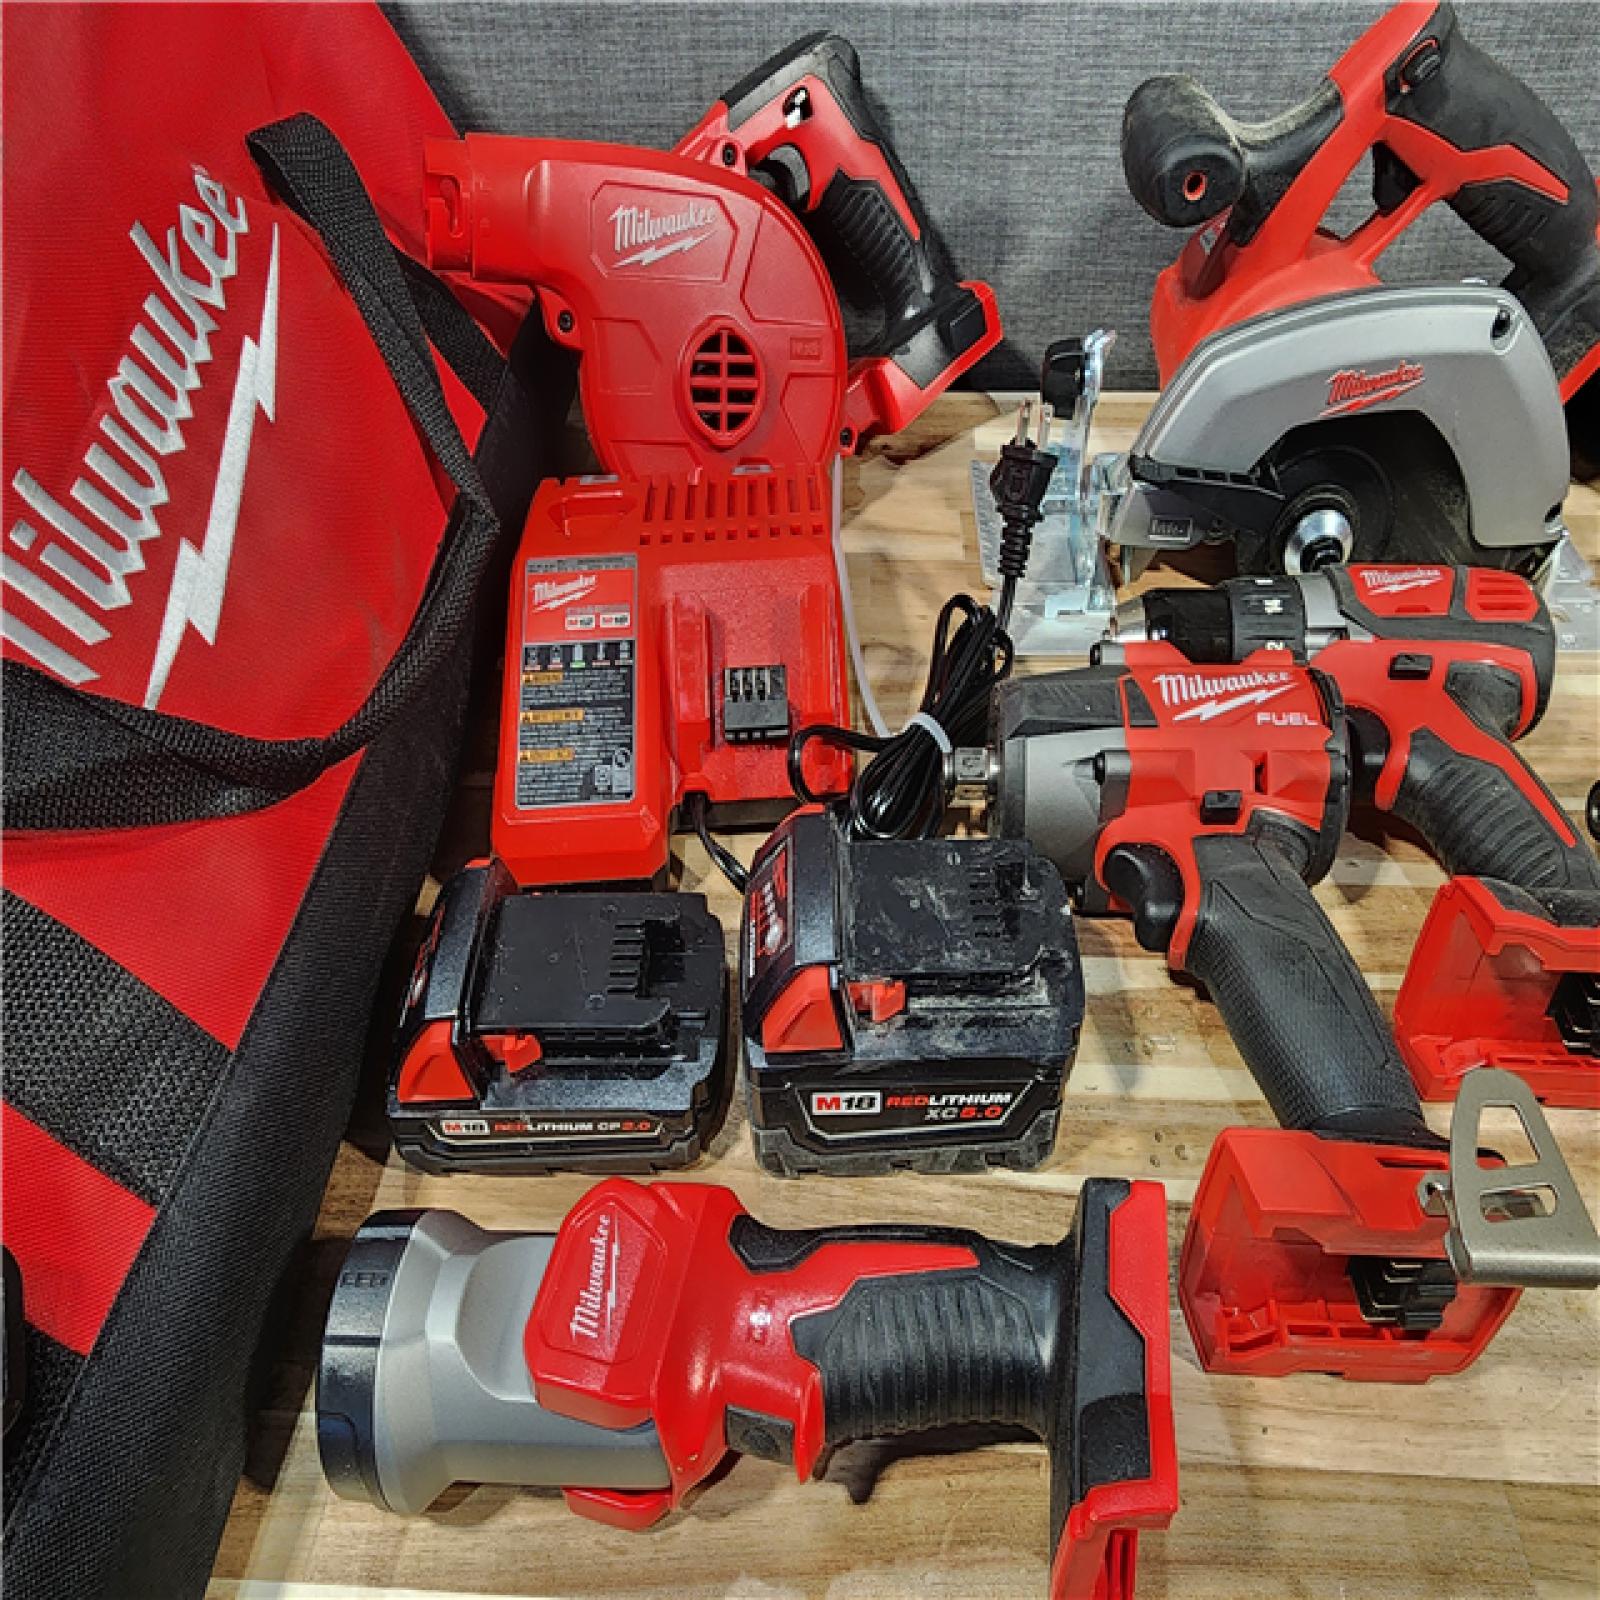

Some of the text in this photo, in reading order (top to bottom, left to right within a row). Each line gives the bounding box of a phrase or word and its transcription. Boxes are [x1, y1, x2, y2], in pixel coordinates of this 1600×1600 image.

[607, 201, 718, 252] Milwaukee
[1325, 359, 1424, 405] Milwaukee
[531, 574, 596, 605] Milwaukee
[1360, 568, 1440, 588] Milwaukee
[1152, 671, 1291, 706] Milwaukee
[1257, 712, 1319, 726] FUEL
[814, 1092, 1012, 1112] M18 REDLITHIUM
[494, 1121, 593, 1132] REDLITHIUM
[570, 1214, 610, 1341] Milwaukee
